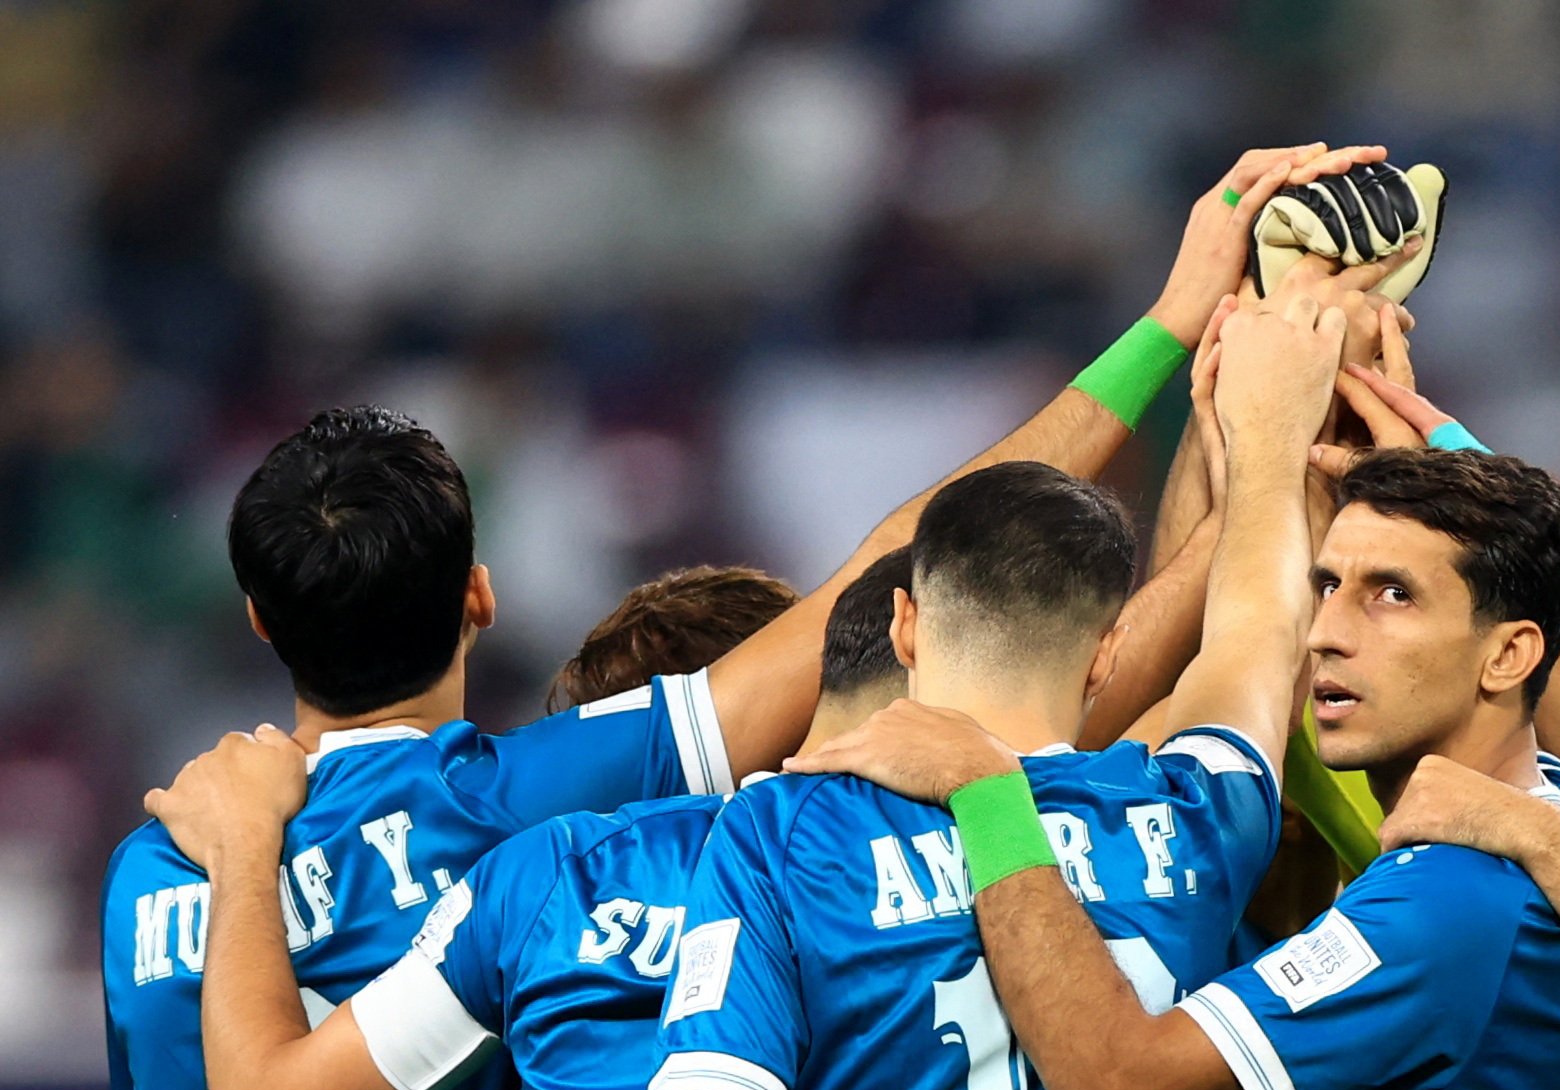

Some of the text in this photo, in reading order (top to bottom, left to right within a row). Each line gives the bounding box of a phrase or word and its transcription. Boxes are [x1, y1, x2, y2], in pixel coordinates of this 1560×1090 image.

[360, 810, 453, 910] Y.
[869, 802, 1197, 930] AMR F.
[1303, 938, 1341, 975] UNITES
